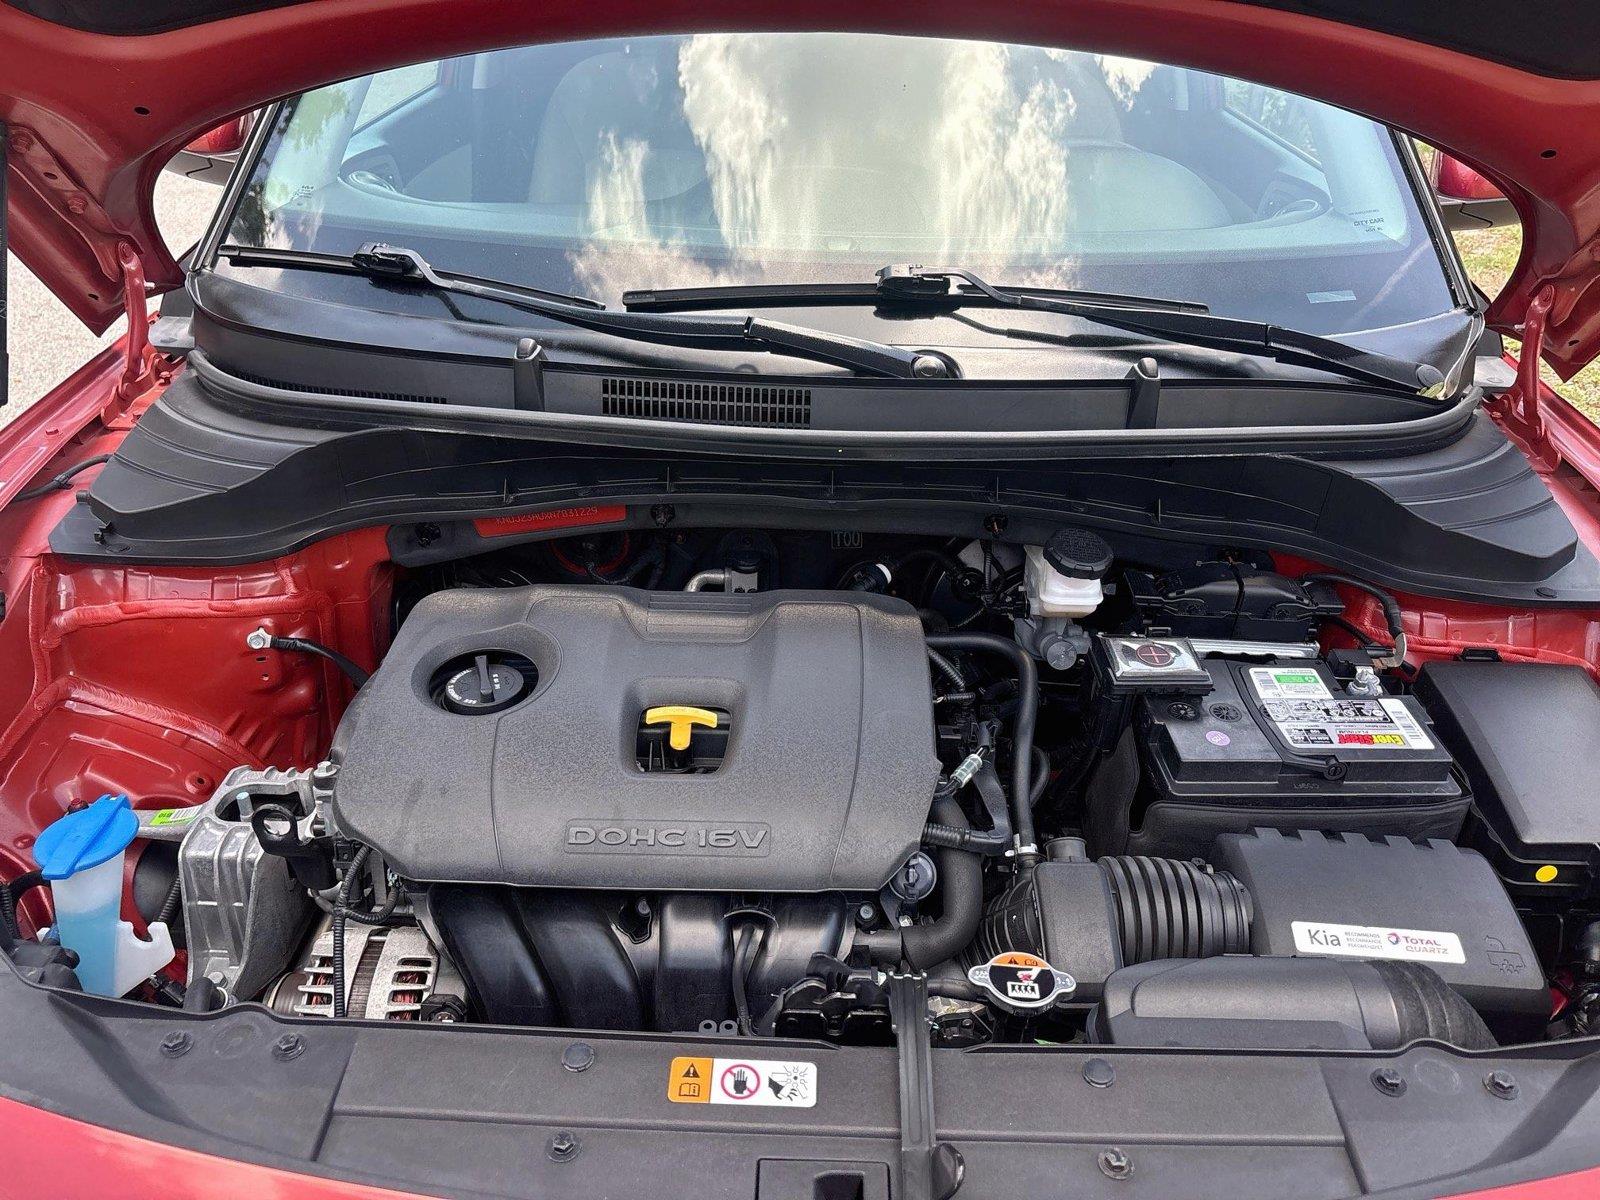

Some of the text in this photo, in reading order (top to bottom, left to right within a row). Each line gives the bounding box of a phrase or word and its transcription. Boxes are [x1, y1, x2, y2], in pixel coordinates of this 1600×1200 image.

[567, 826, 768, 849] DOHC 16V
[1307, 928, 1342, 947] Kia
[1402, 936, 1441, 946] TOTAL
[1405, 946, 1448, 954] QUARTZ
